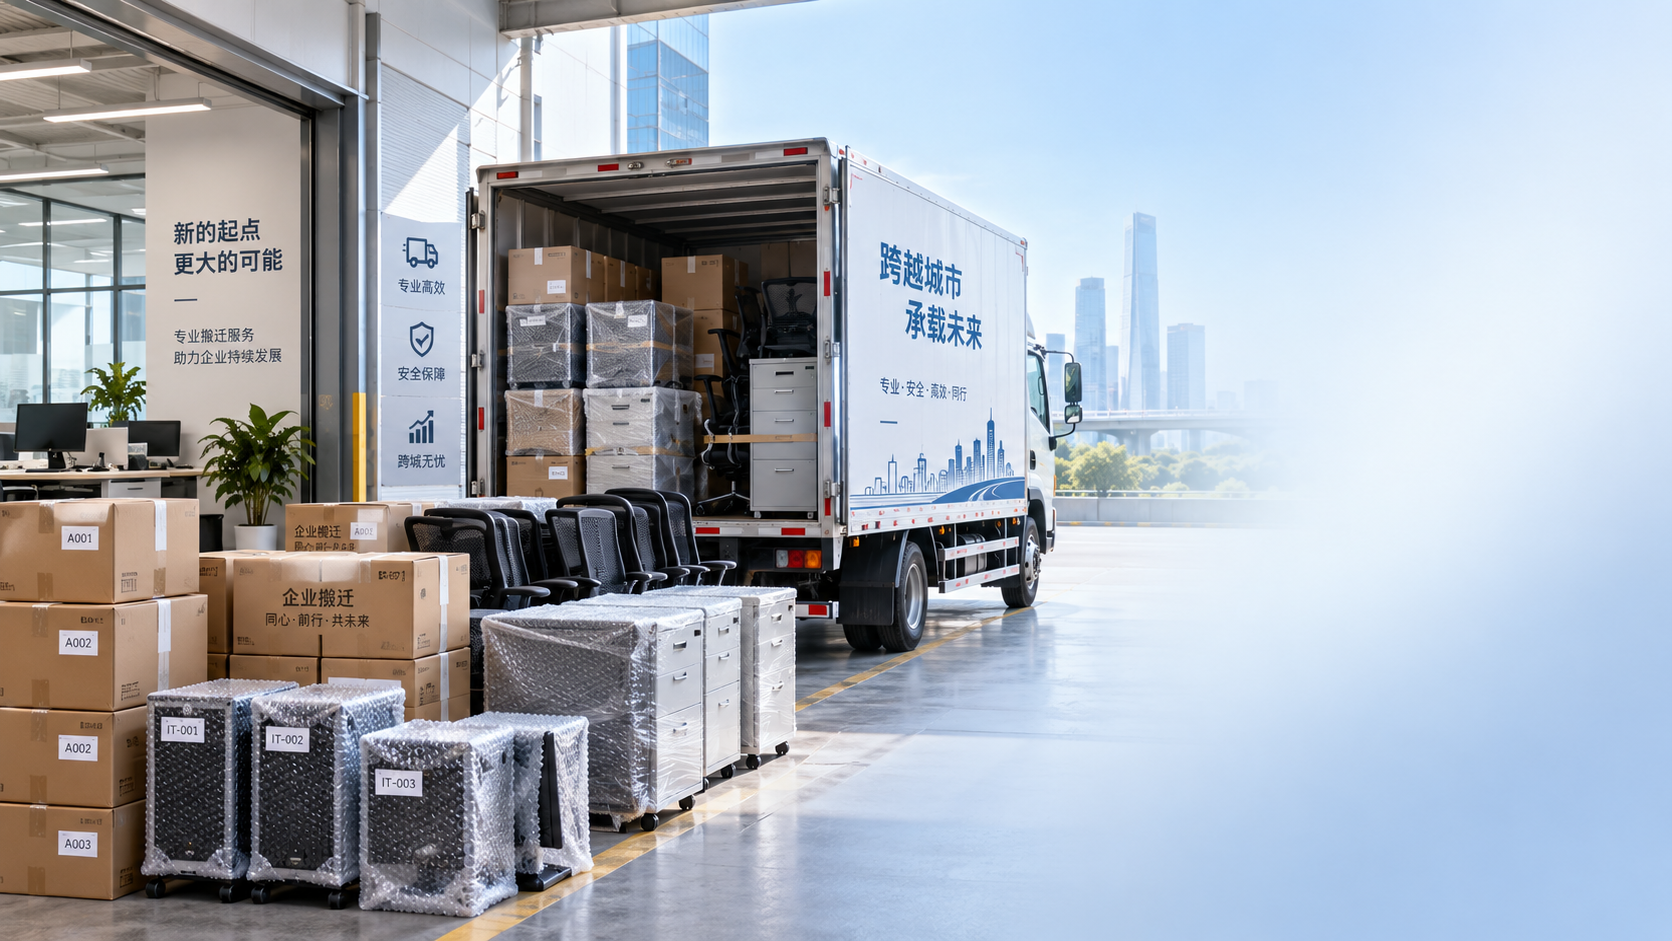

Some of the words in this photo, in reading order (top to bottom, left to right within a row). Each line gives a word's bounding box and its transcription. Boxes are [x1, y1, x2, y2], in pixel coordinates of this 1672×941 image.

[174, 217, 261, 245] 新的起点
[174, 247, 283, 276] 更大的可能
[879, 241, 963, 301] 跨越城市
[397, 278, 446, 295] 专业高效
[904, 298, 983, 351] 承载未来
[174, 327, 254, 345] 专业搬迁服务
[174, 347, 283, 366] 助力企业持续发展
[397, 365, 446, 382] 安全保障
[397, 454, 446, 469] 跨城无忧
[67, 533, 92, 544] A001
[294, 524, 342, 539] 企业搬迁
[282, 587, 355, 608] 企业搬迁
[64, 637, 92, 649] A002
[167, 724, 199, 736] IT-001
[271, 733, 304, 745] IT-002
[64, 742, 92, 754] A002
[381, 777, 416, 789] IT-003
[64, 838, 92, 850] A003
